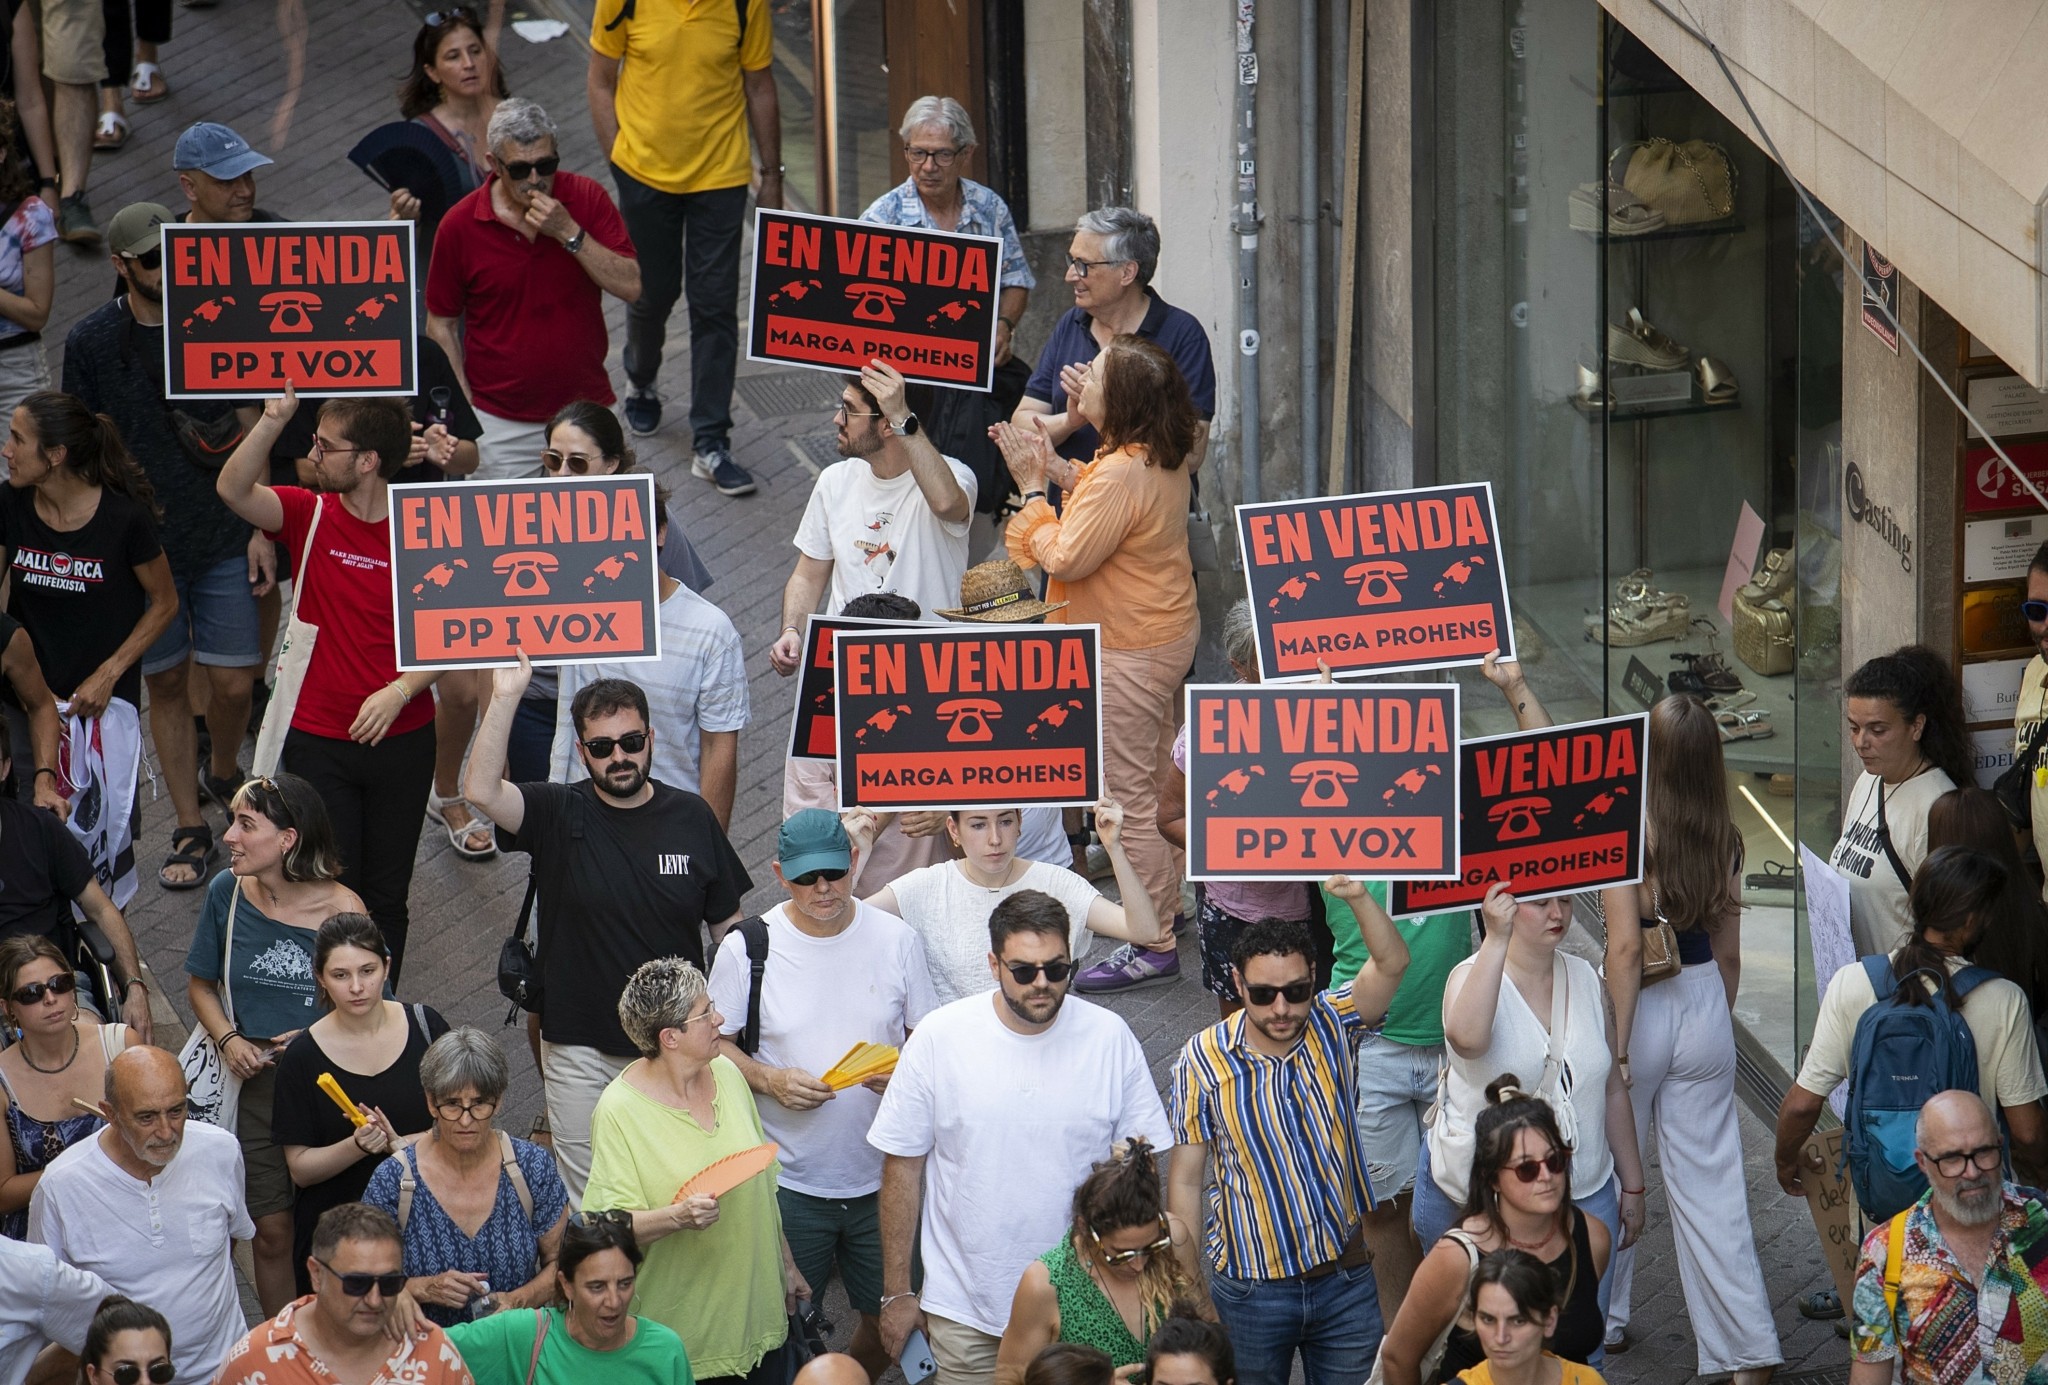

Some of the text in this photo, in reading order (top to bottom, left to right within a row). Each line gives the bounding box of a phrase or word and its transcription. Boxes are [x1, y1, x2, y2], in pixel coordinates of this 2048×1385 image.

[174, 234, 405, 286] EN VENDA
[765, 221, 989, 293] EN VENDA
[210, 349, 378, 380] PP I VOX
[770, 328, 976, 371] MARGA PROHENS
[402, 489, 645, 550] EN VENDA
[1249, 495, 1489, 566] EN VENDA
[1845, 461, 1912, 573] Casting
[329, 549, 347, 559] MAKE
[356, 562, 374, 570] AGAIN
[23, 572, 86, 593] ANTIFEIXISTA
[442, 612, 618, 649] PP I VOX
[1279, 619, 1492, 657] MARGA PROHENS
[846, 637, 1091, 696] EN VENDA
[1199, 698, 1449, 754] EN VENDA
[861, 764, 1082, 787] MARGA PROHENS
[1475, 728, 1637, 797] VENDA
[1235, 827, 1416, 859] PP I VOX
[1508, 846, 1624, 881] PROHENS
[1839, 847, 1875, 879] RUMB
